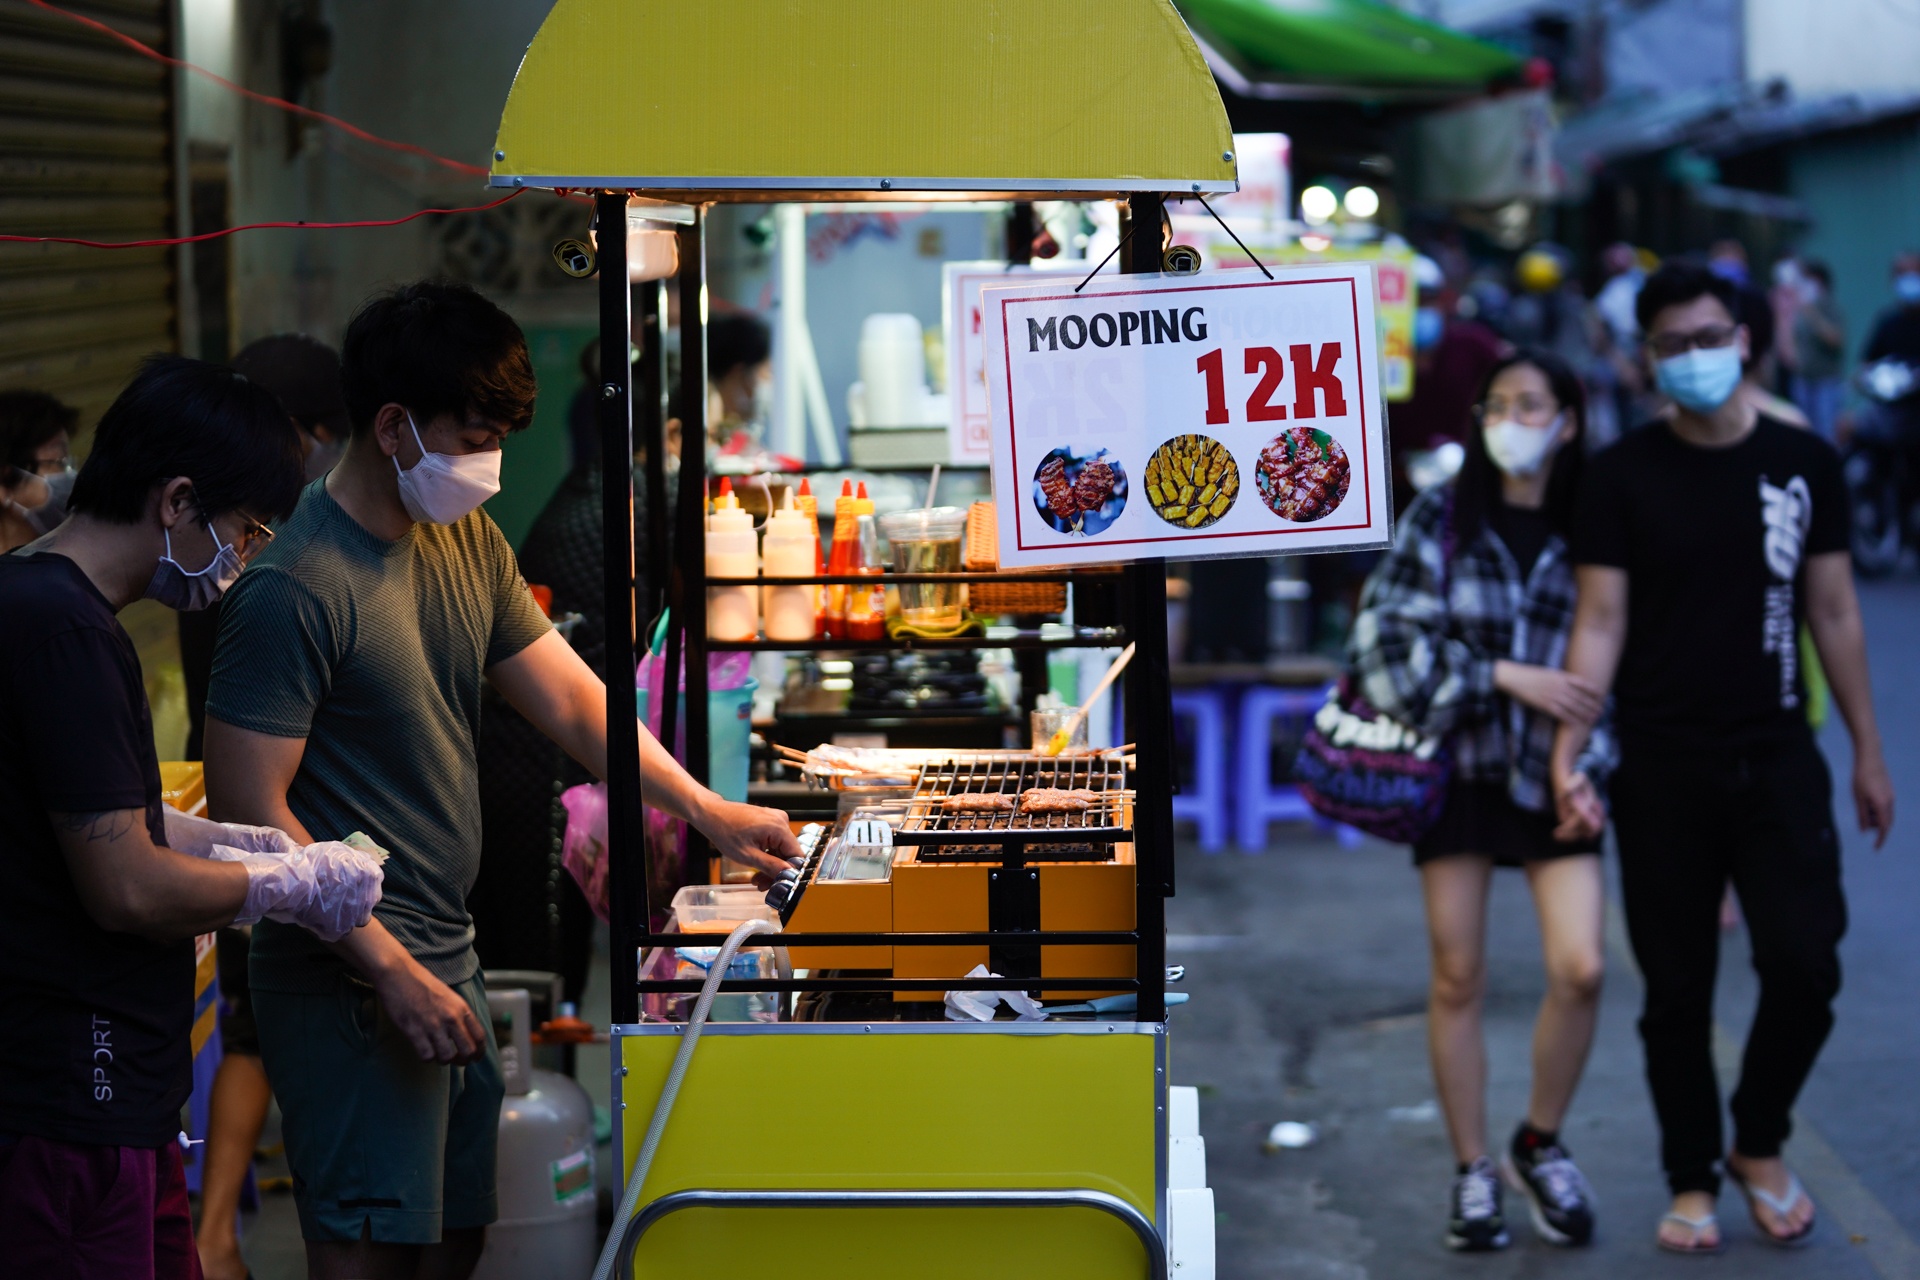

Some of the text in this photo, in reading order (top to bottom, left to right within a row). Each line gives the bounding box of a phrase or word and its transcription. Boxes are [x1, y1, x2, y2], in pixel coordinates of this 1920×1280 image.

[1026, 307, 1207, 352] MOOPING
[1197, 342, 1347, 425] 12K
[92, 1013, 113, 1101] SPORT
